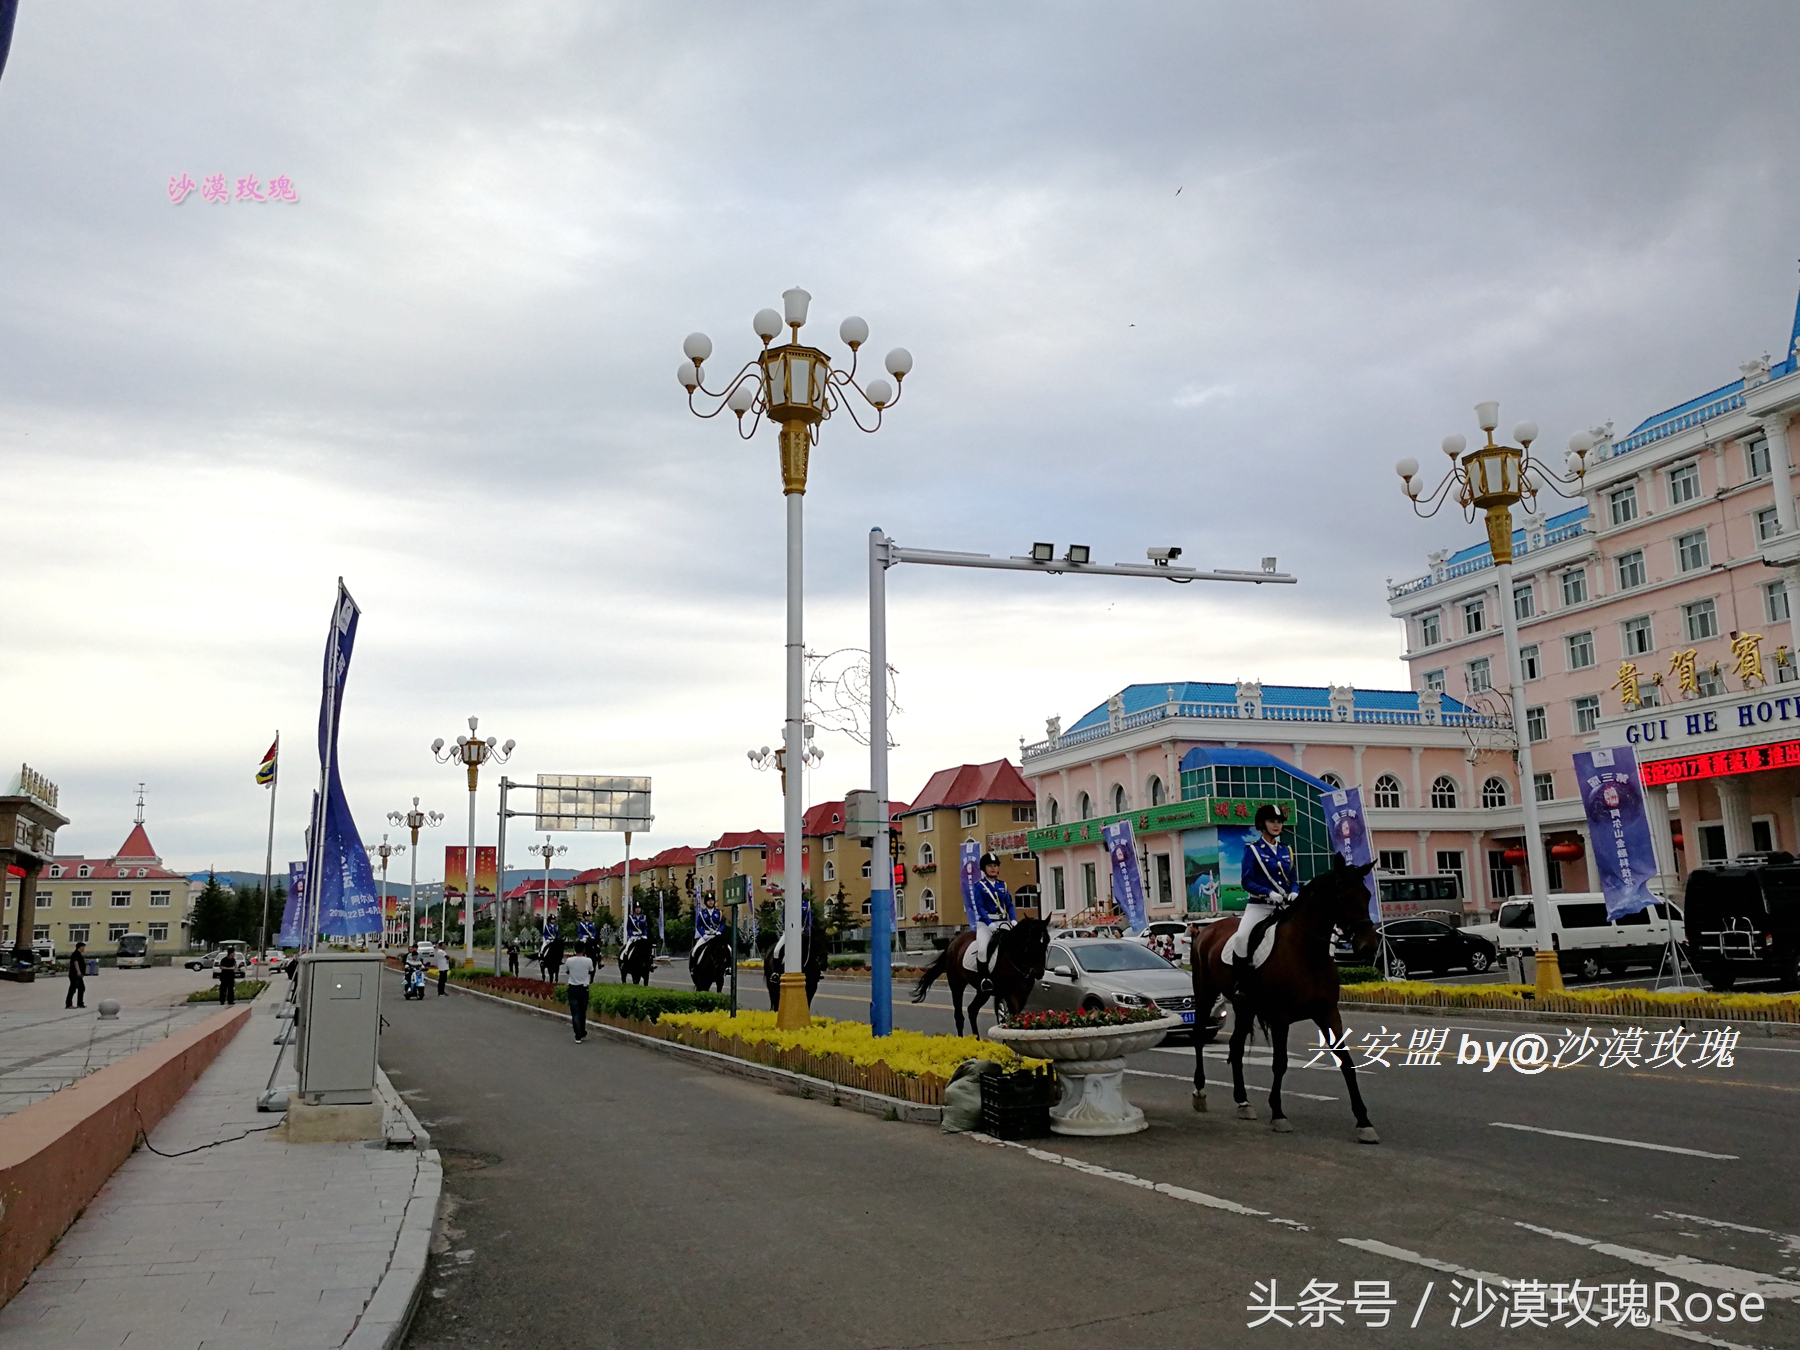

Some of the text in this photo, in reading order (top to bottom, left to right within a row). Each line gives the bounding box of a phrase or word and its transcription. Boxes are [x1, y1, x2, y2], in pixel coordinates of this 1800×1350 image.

[1626, 719, 1668, 744] GUI
[1685, 710, 1718, 735] HE
[1214, 801, 1292, 821] 明珠厅
